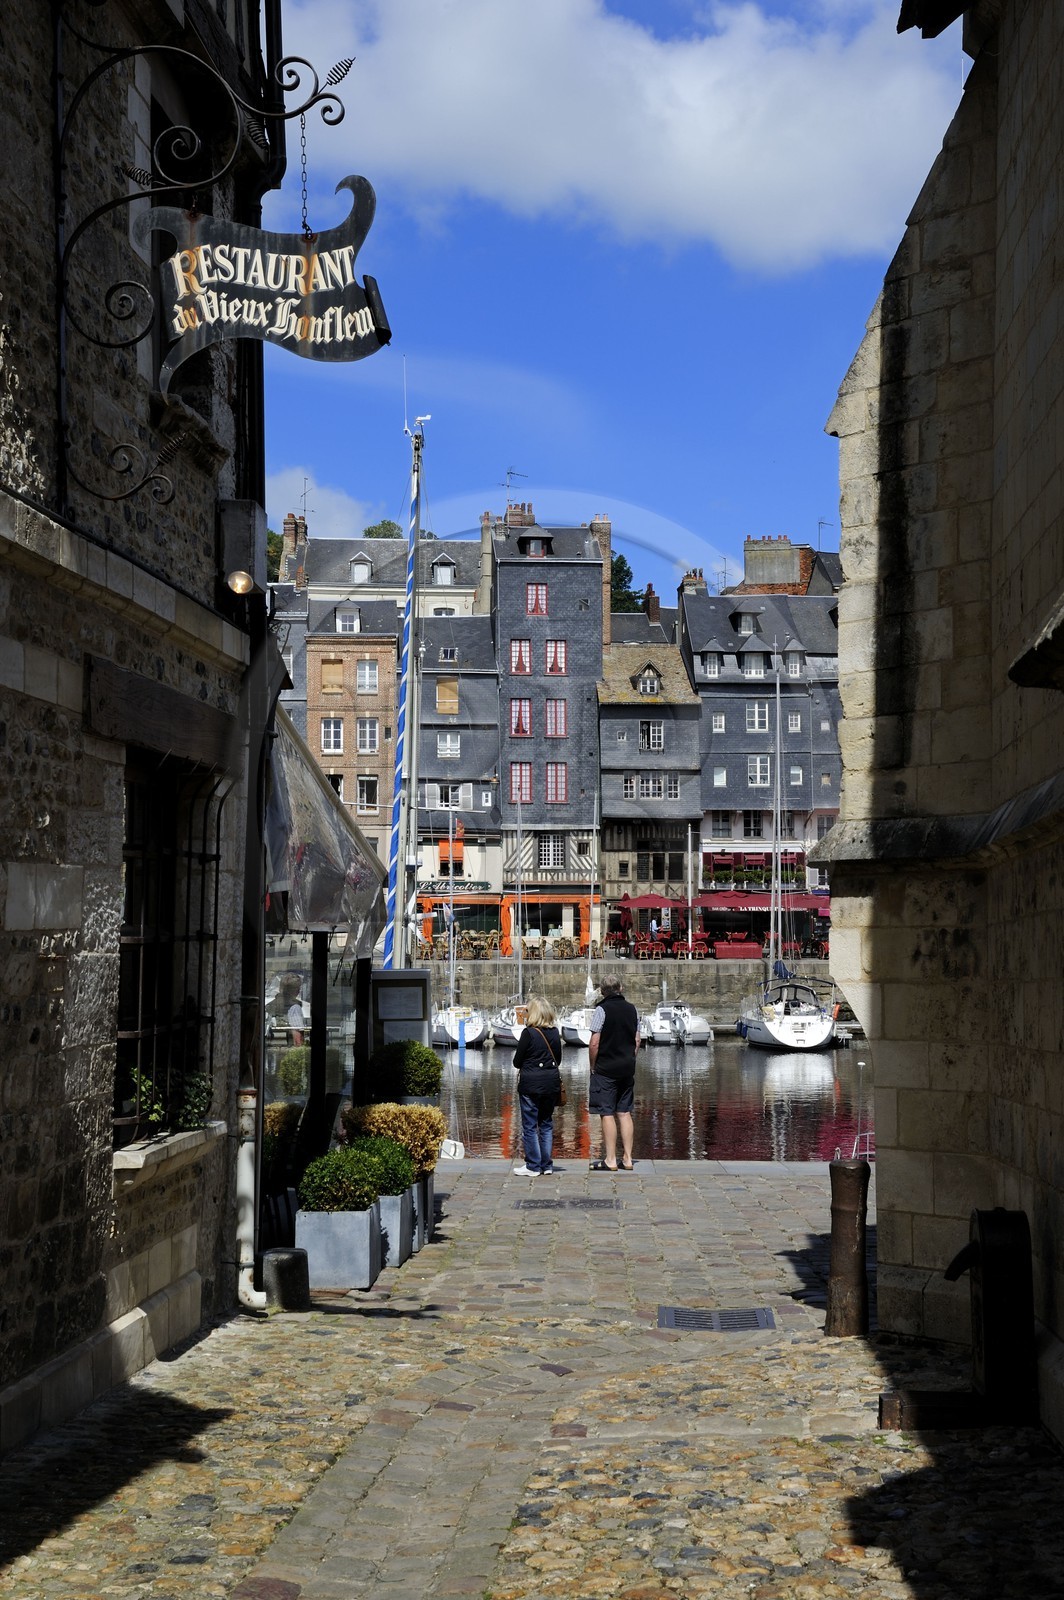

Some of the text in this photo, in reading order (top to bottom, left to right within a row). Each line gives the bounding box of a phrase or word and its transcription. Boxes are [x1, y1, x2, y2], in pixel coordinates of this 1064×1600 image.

[168, 244, 355, 301] RESTAURANT
[172, 303, 203, 335] du
[196, 290, 273, 328] Vieux
